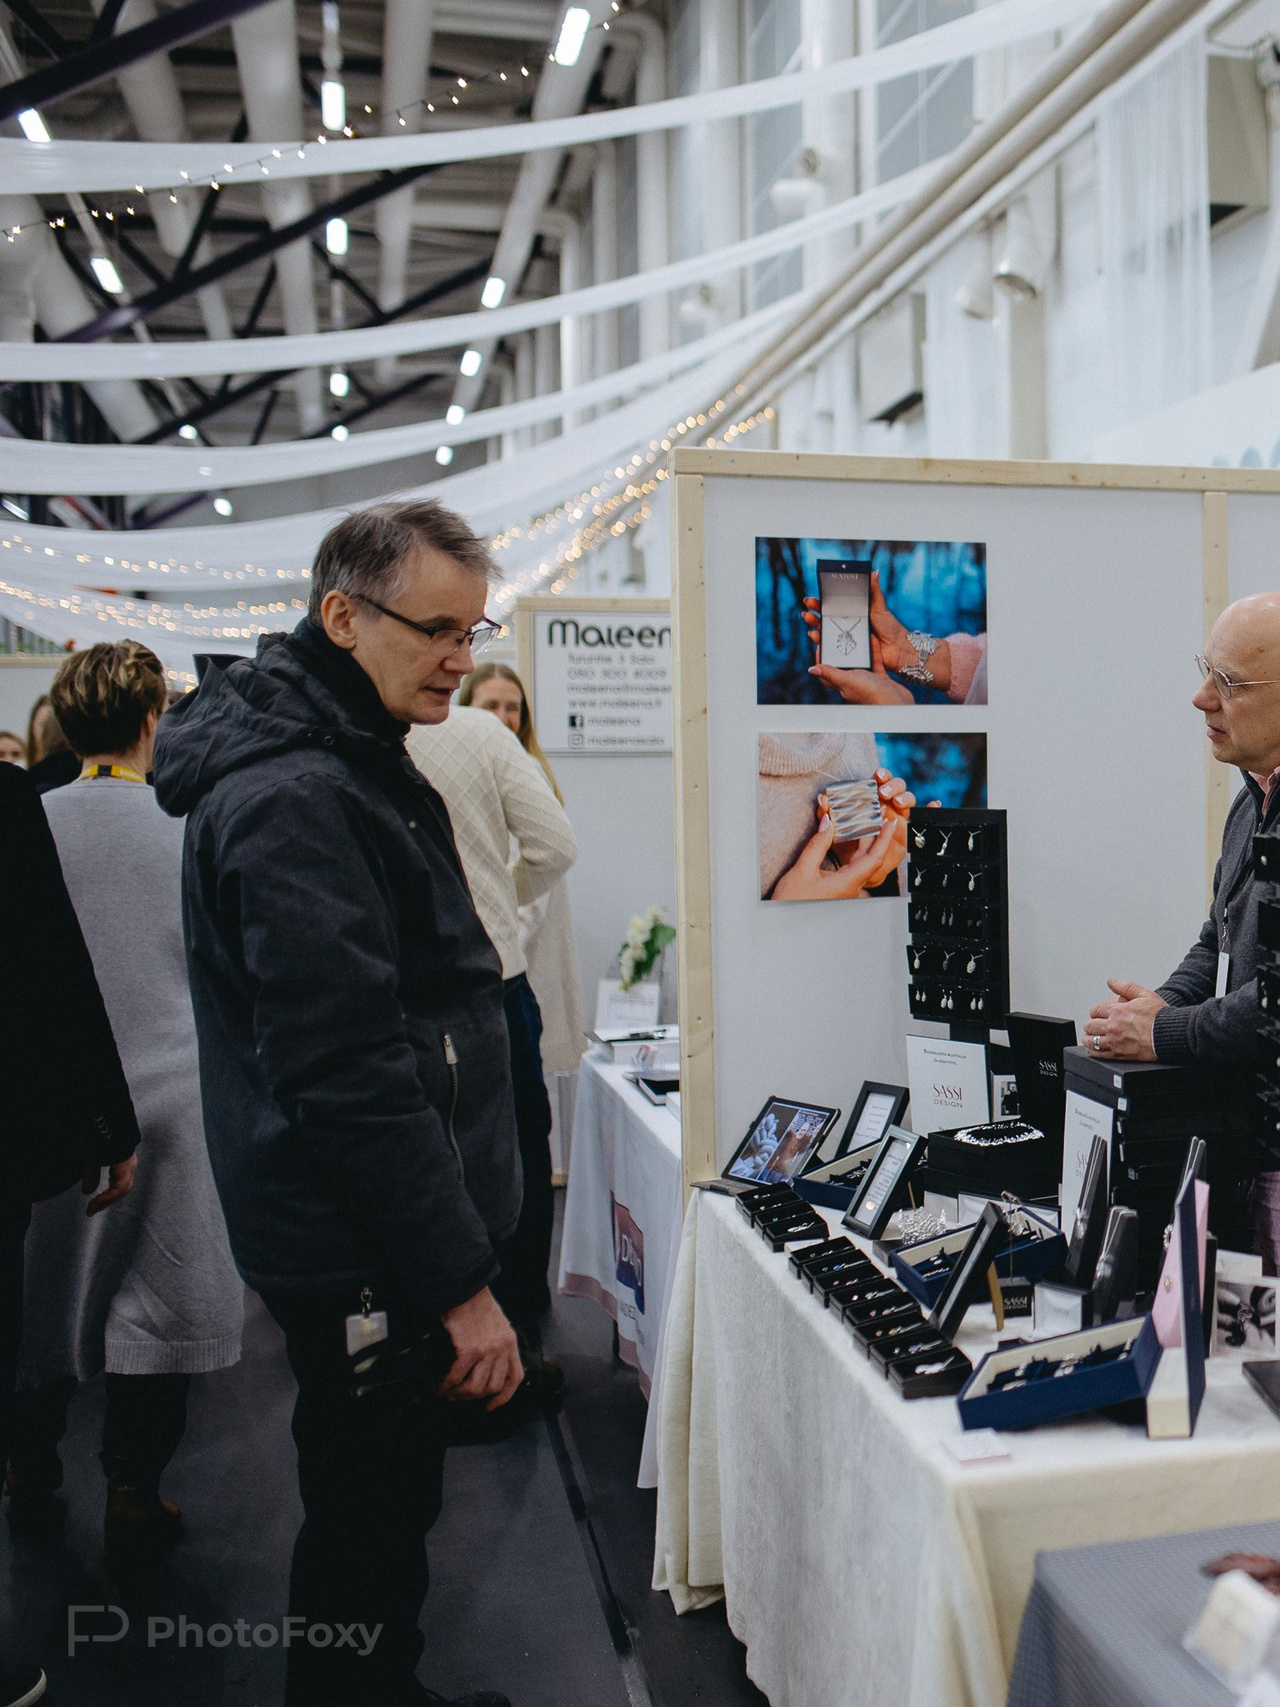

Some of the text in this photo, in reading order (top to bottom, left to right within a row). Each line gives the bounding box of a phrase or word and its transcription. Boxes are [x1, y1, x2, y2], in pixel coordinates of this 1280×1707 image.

[1038, 1060, 1057, 1072] SASSI
[933, 1084, 962, 1101] SASSI
[933, 1099, 963, 1108] DESIGN
